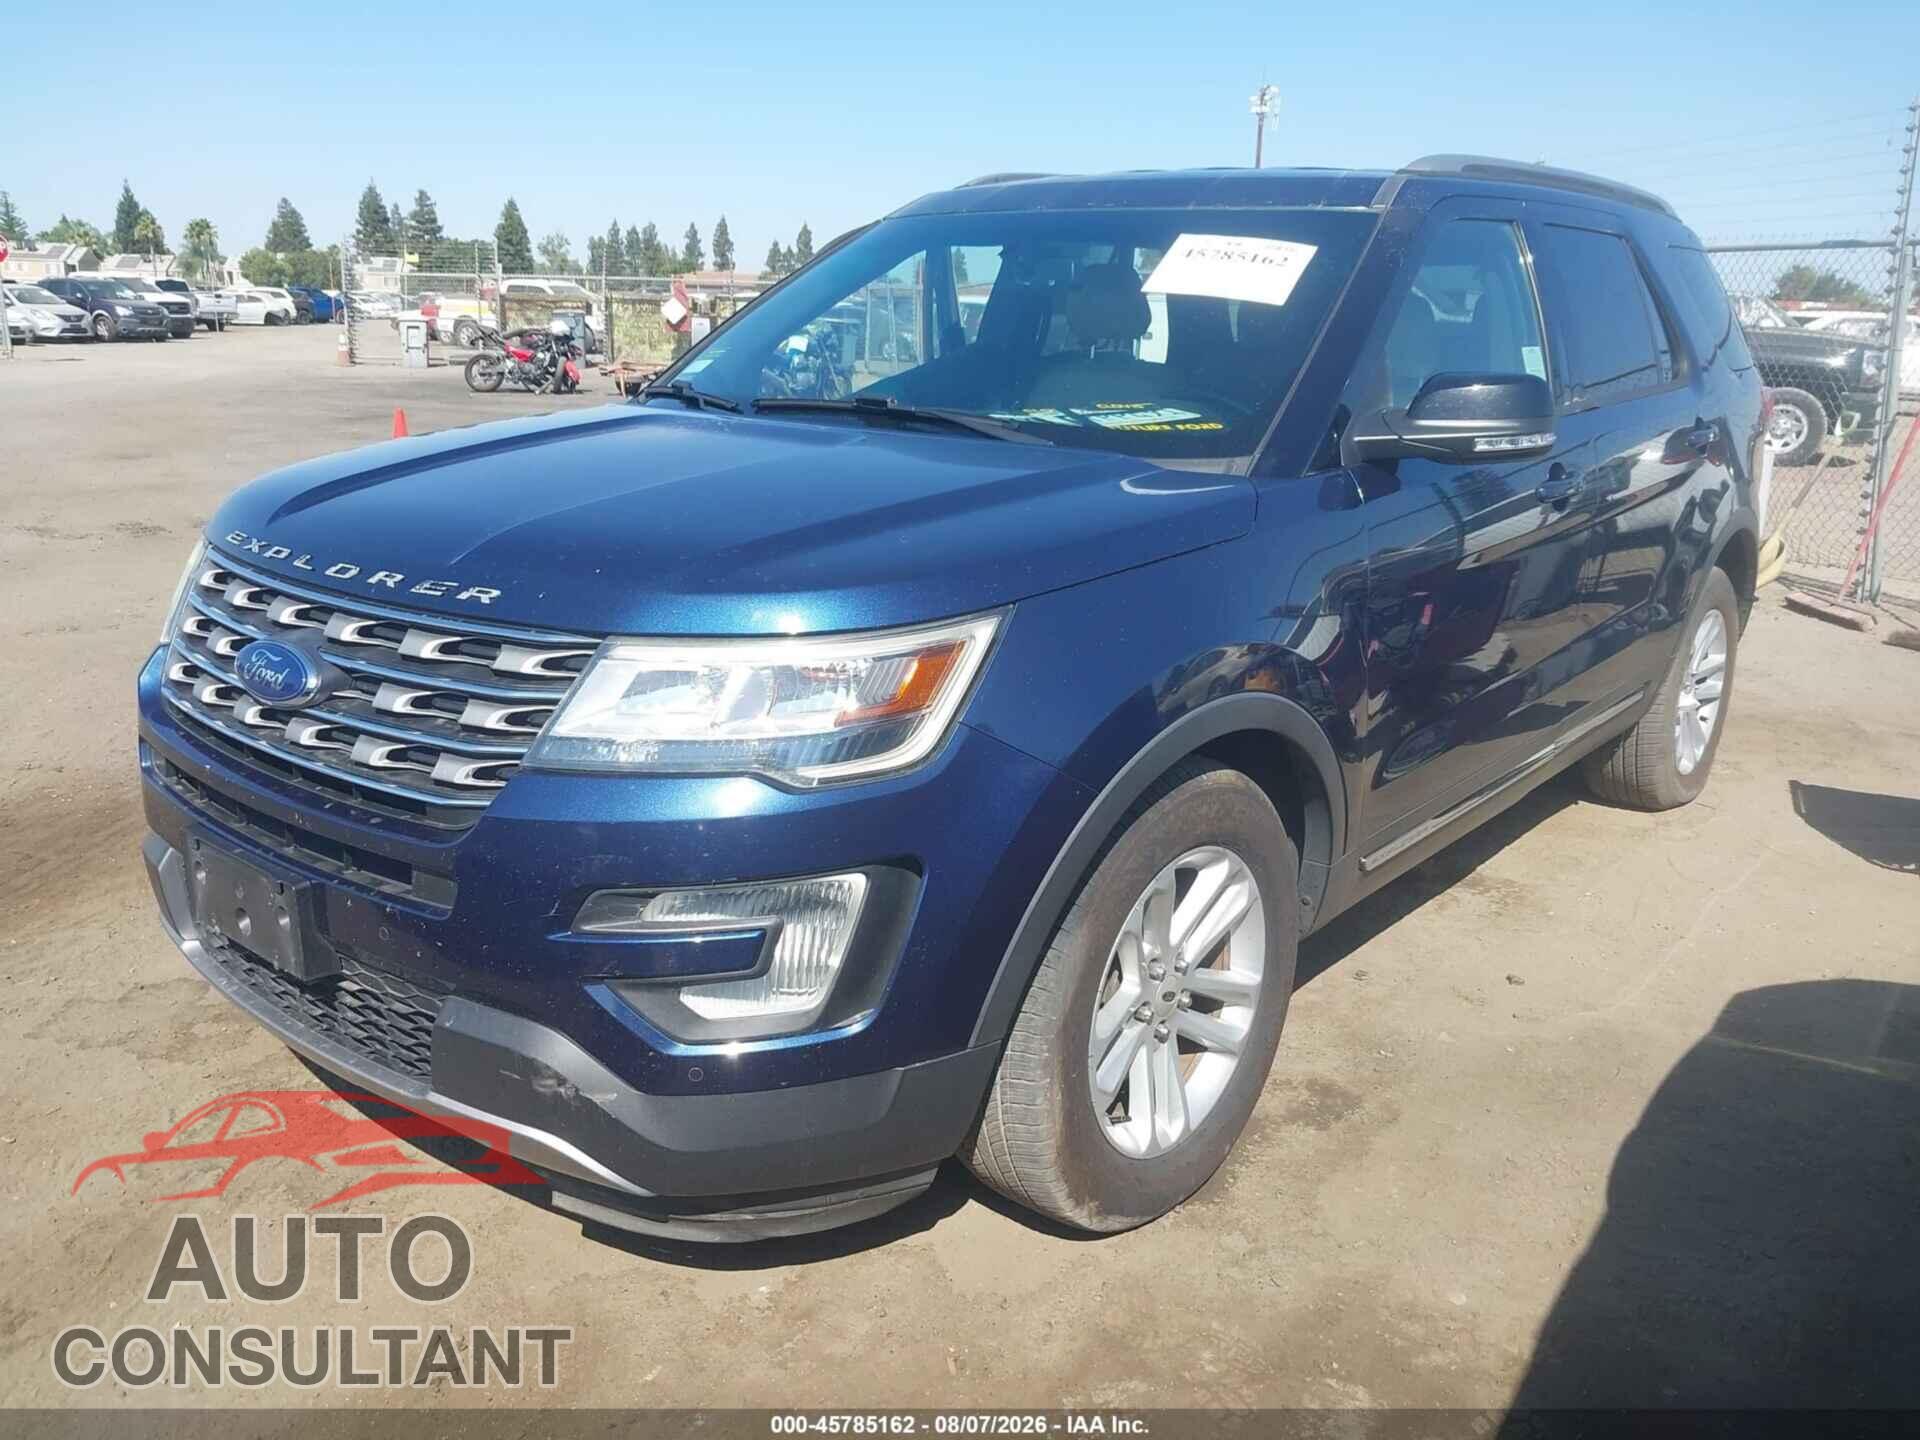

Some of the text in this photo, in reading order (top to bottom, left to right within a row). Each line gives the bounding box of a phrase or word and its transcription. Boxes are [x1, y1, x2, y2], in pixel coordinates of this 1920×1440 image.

[1175, 422, 1224, 431] FORD
[226, 530, 503, 605] EXPLORER
[243, 647, 291, 691] Ford
